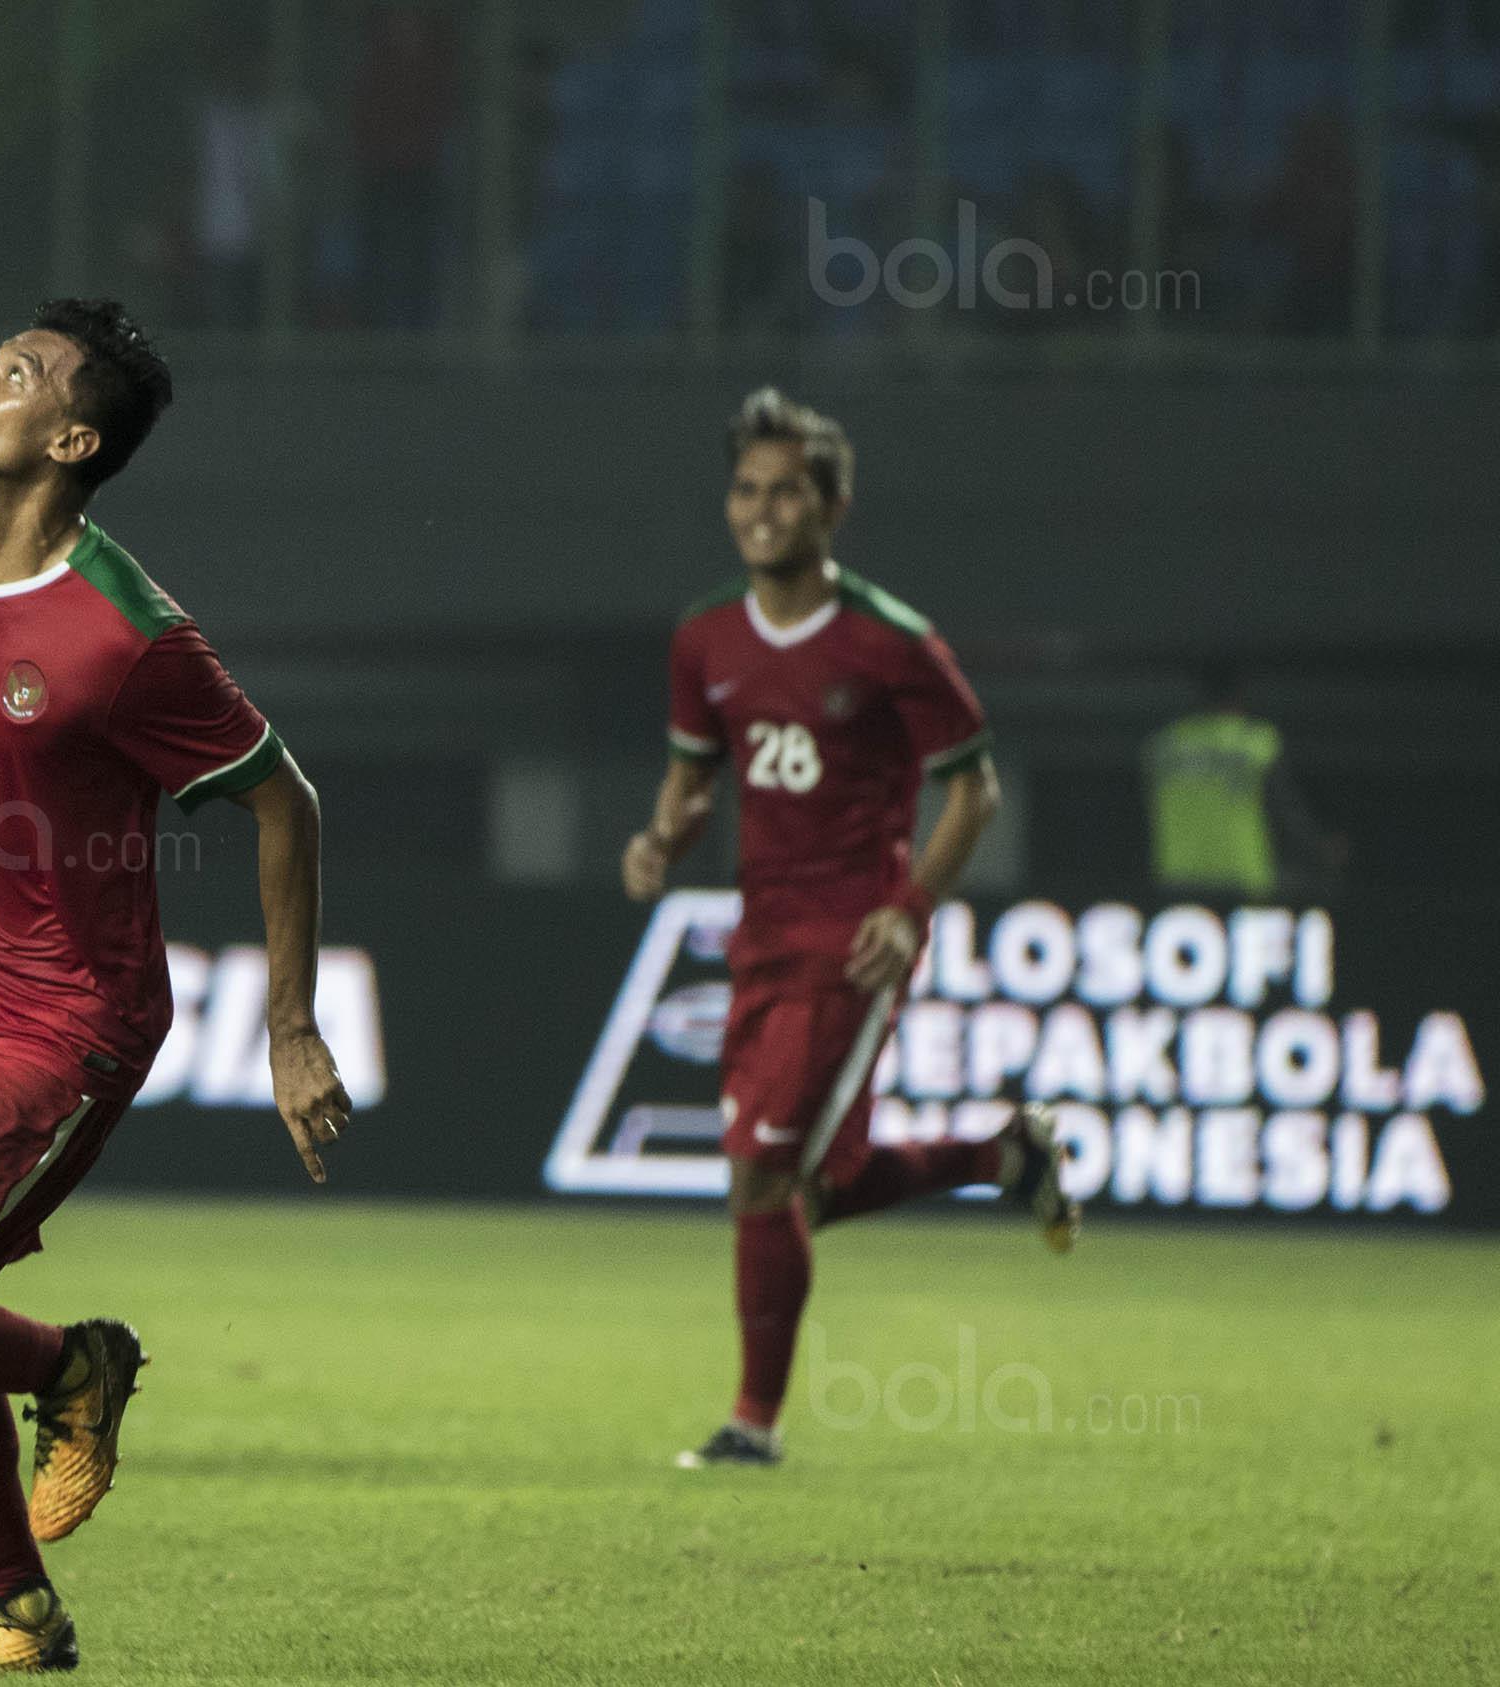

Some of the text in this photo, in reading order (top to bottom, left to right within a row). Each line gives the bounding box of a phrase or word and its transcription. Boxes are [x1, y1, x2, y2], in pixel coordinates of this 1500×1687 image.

[746, 721, 823, 793] 28
[910, 899, 1333, 1007] LOSOFI
[871, 1001, 1483, 1114] EPAKBOLA
